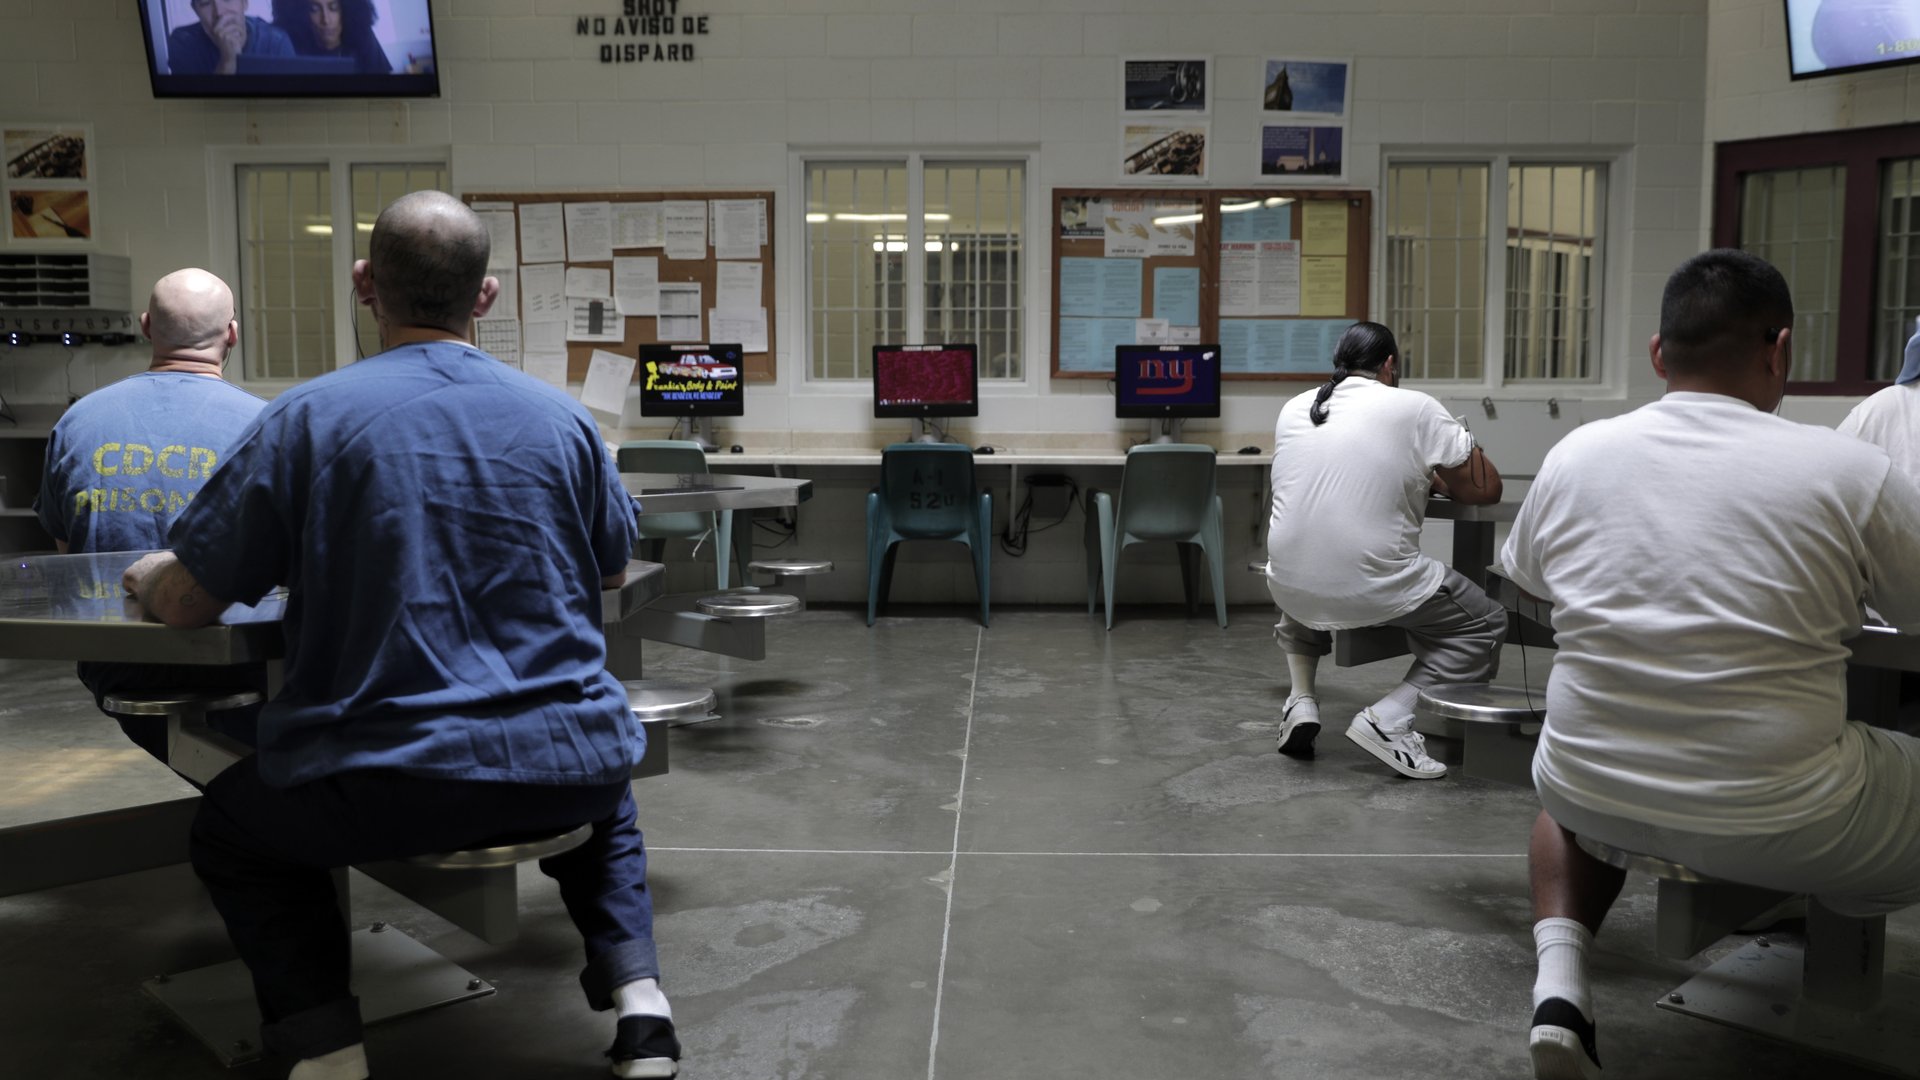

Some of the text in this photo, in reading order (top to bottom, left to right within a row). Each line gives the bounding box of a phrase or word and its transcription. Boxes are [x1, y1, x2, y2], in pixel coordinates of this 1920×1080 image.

[623, 0, 678, 16] SHOT
[577, 17, 708, 35] NO AVISO DE
[600, 44, 693, 63] DISPARO
[715, 380, 738, 391] Paint
[92, 442, 218, 480] CDCR
[75, 487, 195, 516] PRISON
